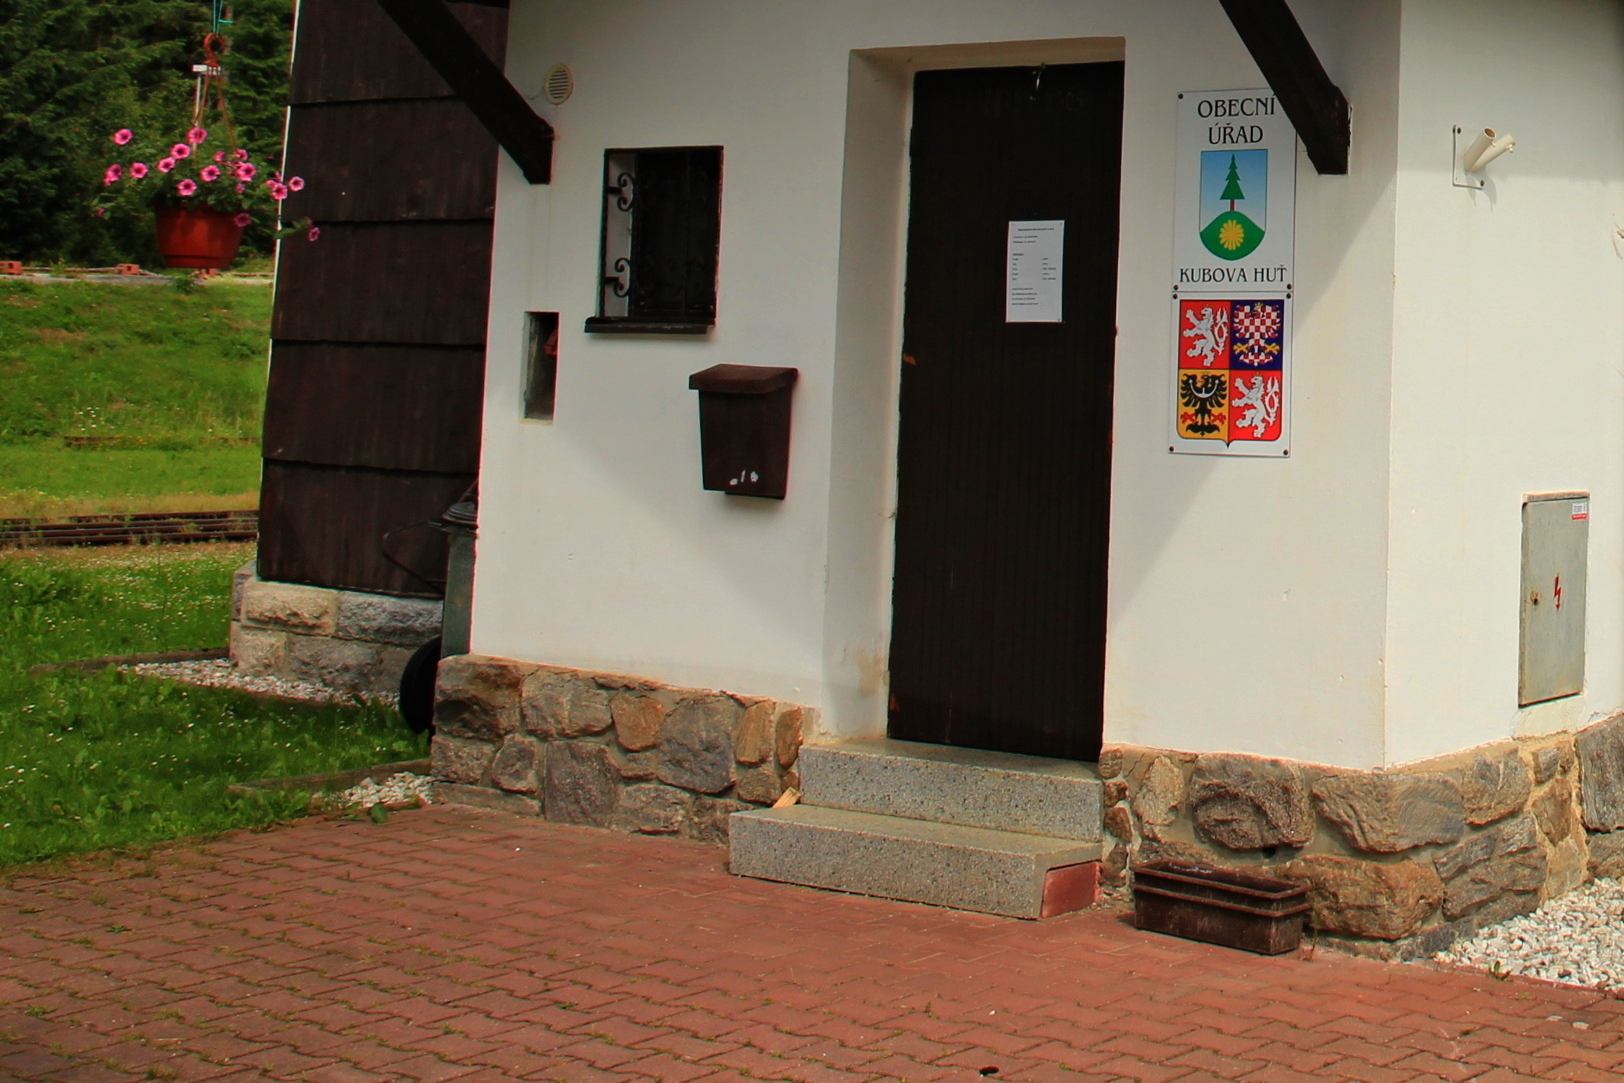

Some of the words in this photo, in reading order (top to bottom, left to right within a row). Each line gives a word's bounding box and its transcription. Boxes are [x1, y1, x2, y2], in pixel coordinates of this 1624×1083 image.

[1197, 92, 1276, 118] OBECNÍ
[1208, 122, 1264, 145] ÚŘAD
[1179, 267, 1248, 283] KUBOVA
[1253, 264, 1288, 282] HUŤ
